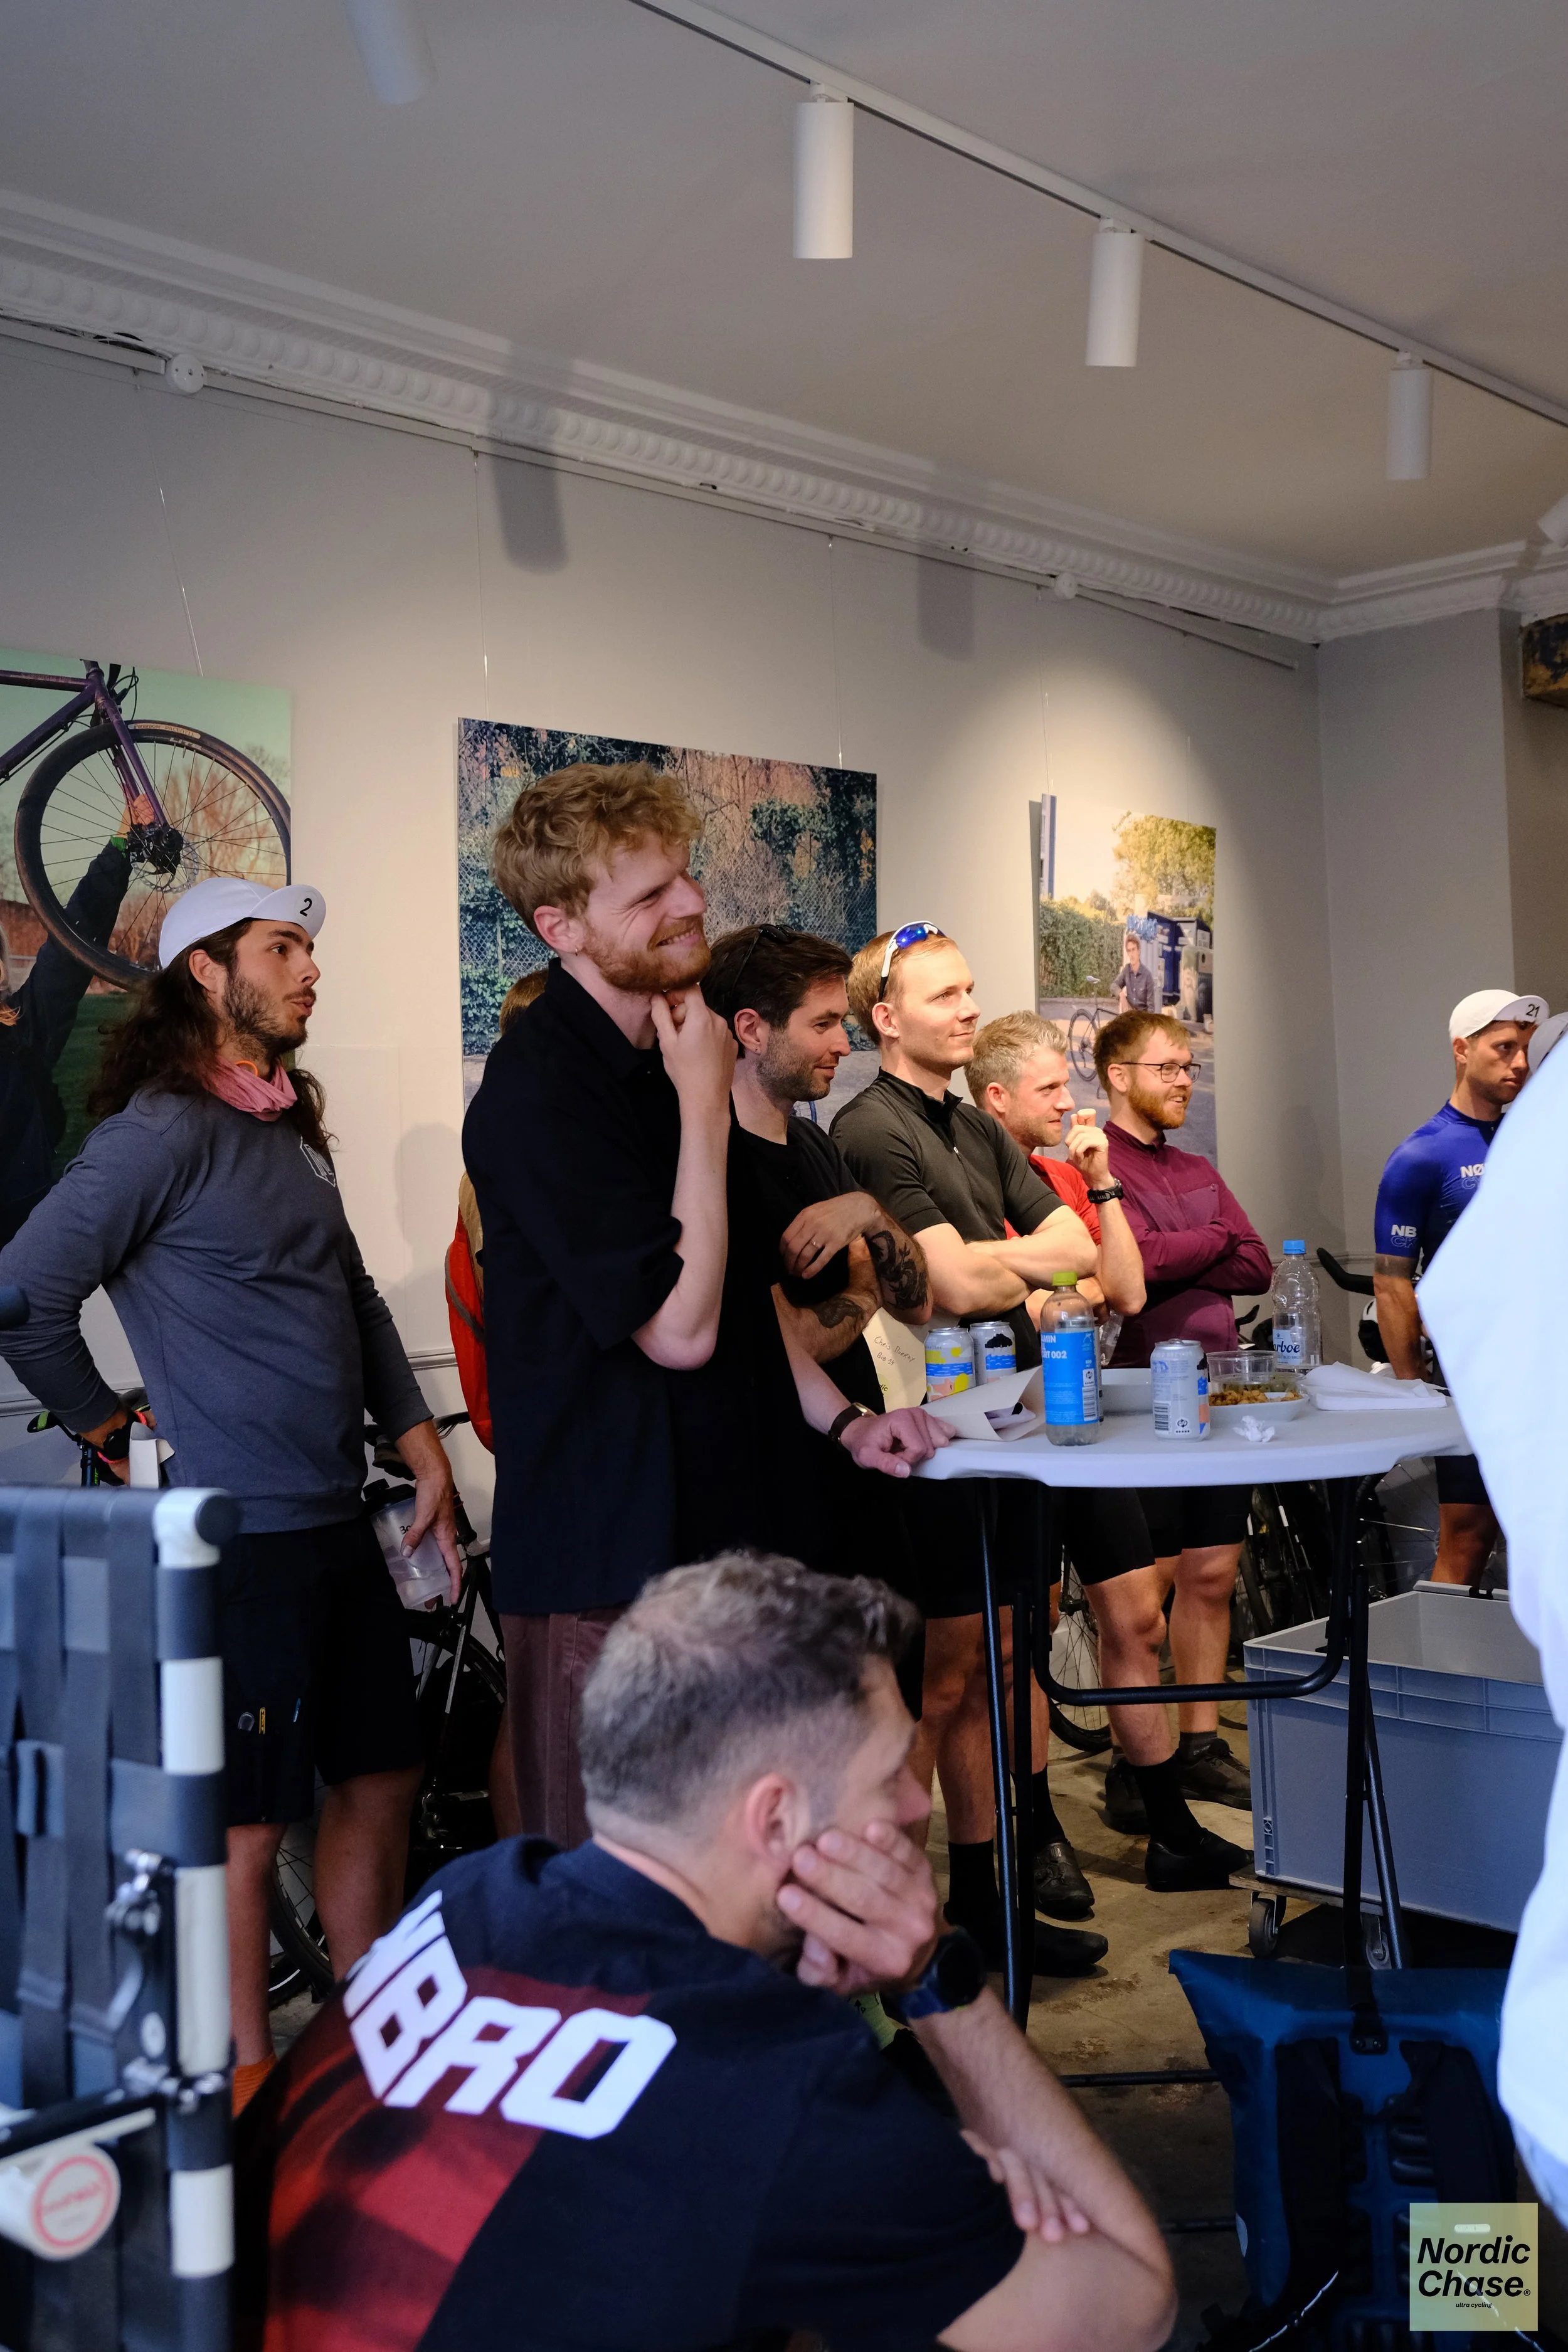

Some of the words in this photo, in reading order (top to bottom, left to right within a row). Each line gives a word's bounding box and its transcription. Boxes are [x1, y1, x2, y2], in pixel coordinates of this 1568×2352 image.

[300, 898, 312, 917] 2
[1525, 1004, 1540, 1017] 21
[1391, 1224, 1417, 1237] NB
[1051, 1350, 1067, 1359] 002
